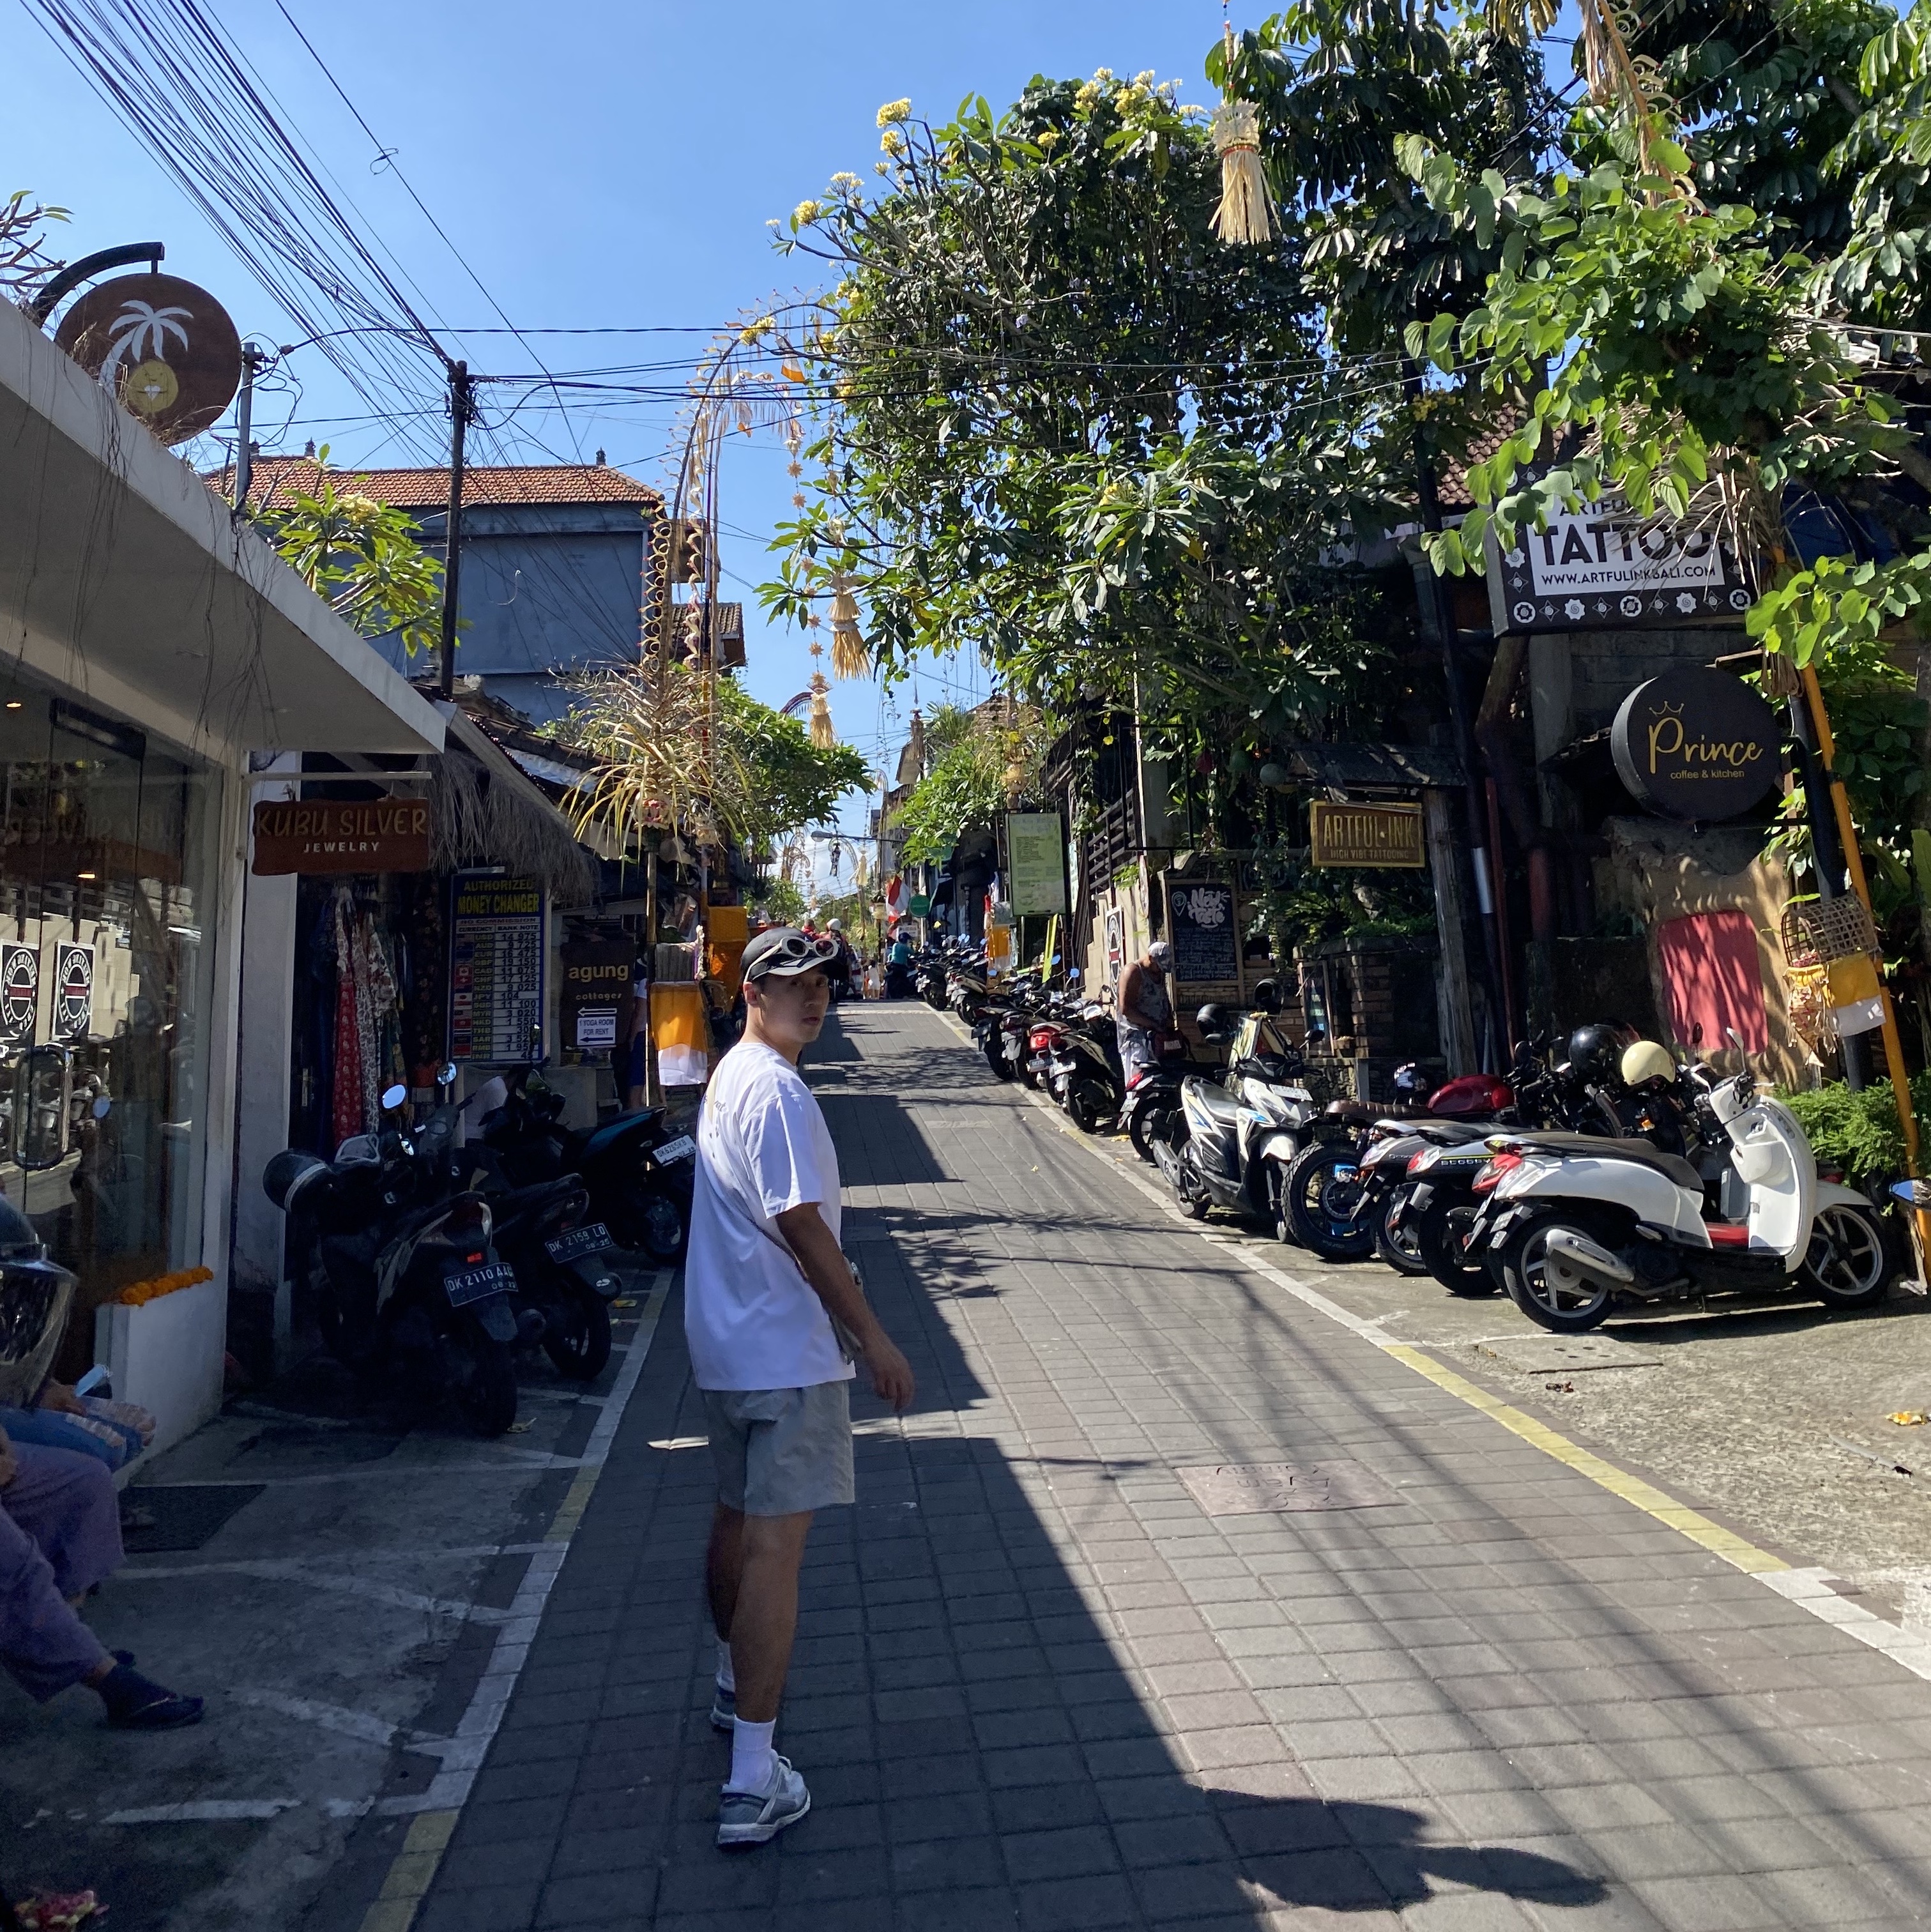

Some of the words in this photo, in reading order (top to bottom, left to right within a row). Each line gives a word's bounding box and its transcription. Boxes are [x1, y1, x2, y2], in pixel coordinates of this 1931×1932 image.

[1534, 521, 1713, 566] TATTOO
[1541, 565, 1716, 585] WWW.ARTFULINKBALI.COM
[1648, 717, 1764, 774] Prince
[1670, 769, 1699, 779] coffee
[1702, 770, 1709, 779] &
[1711, 769, 1744, 779] kitchen
[256, 809, 328, 837] KUBU
[339, 808, 427, 836] SILVER
[1324, 814, 1381, 848] ARTFUL
[1388, 816, 1415, 848] INK
[303, 841, 380, 853] JEWELRY
[464, 879, 533, 892] AUTHORIZED
[458, 895, 491, 914] MONEY
[494, 893, 539, 913] CHANGER
[569, 964, 629, 982] agung
[576, 993, 622, 1001] cottages
[548, 1240, 563, 1252] DK
[565, 1231, 590, 1246] 2159
[447, 1277, 464, 1291] DK
[465, 1268, 494, 1286] 2110
